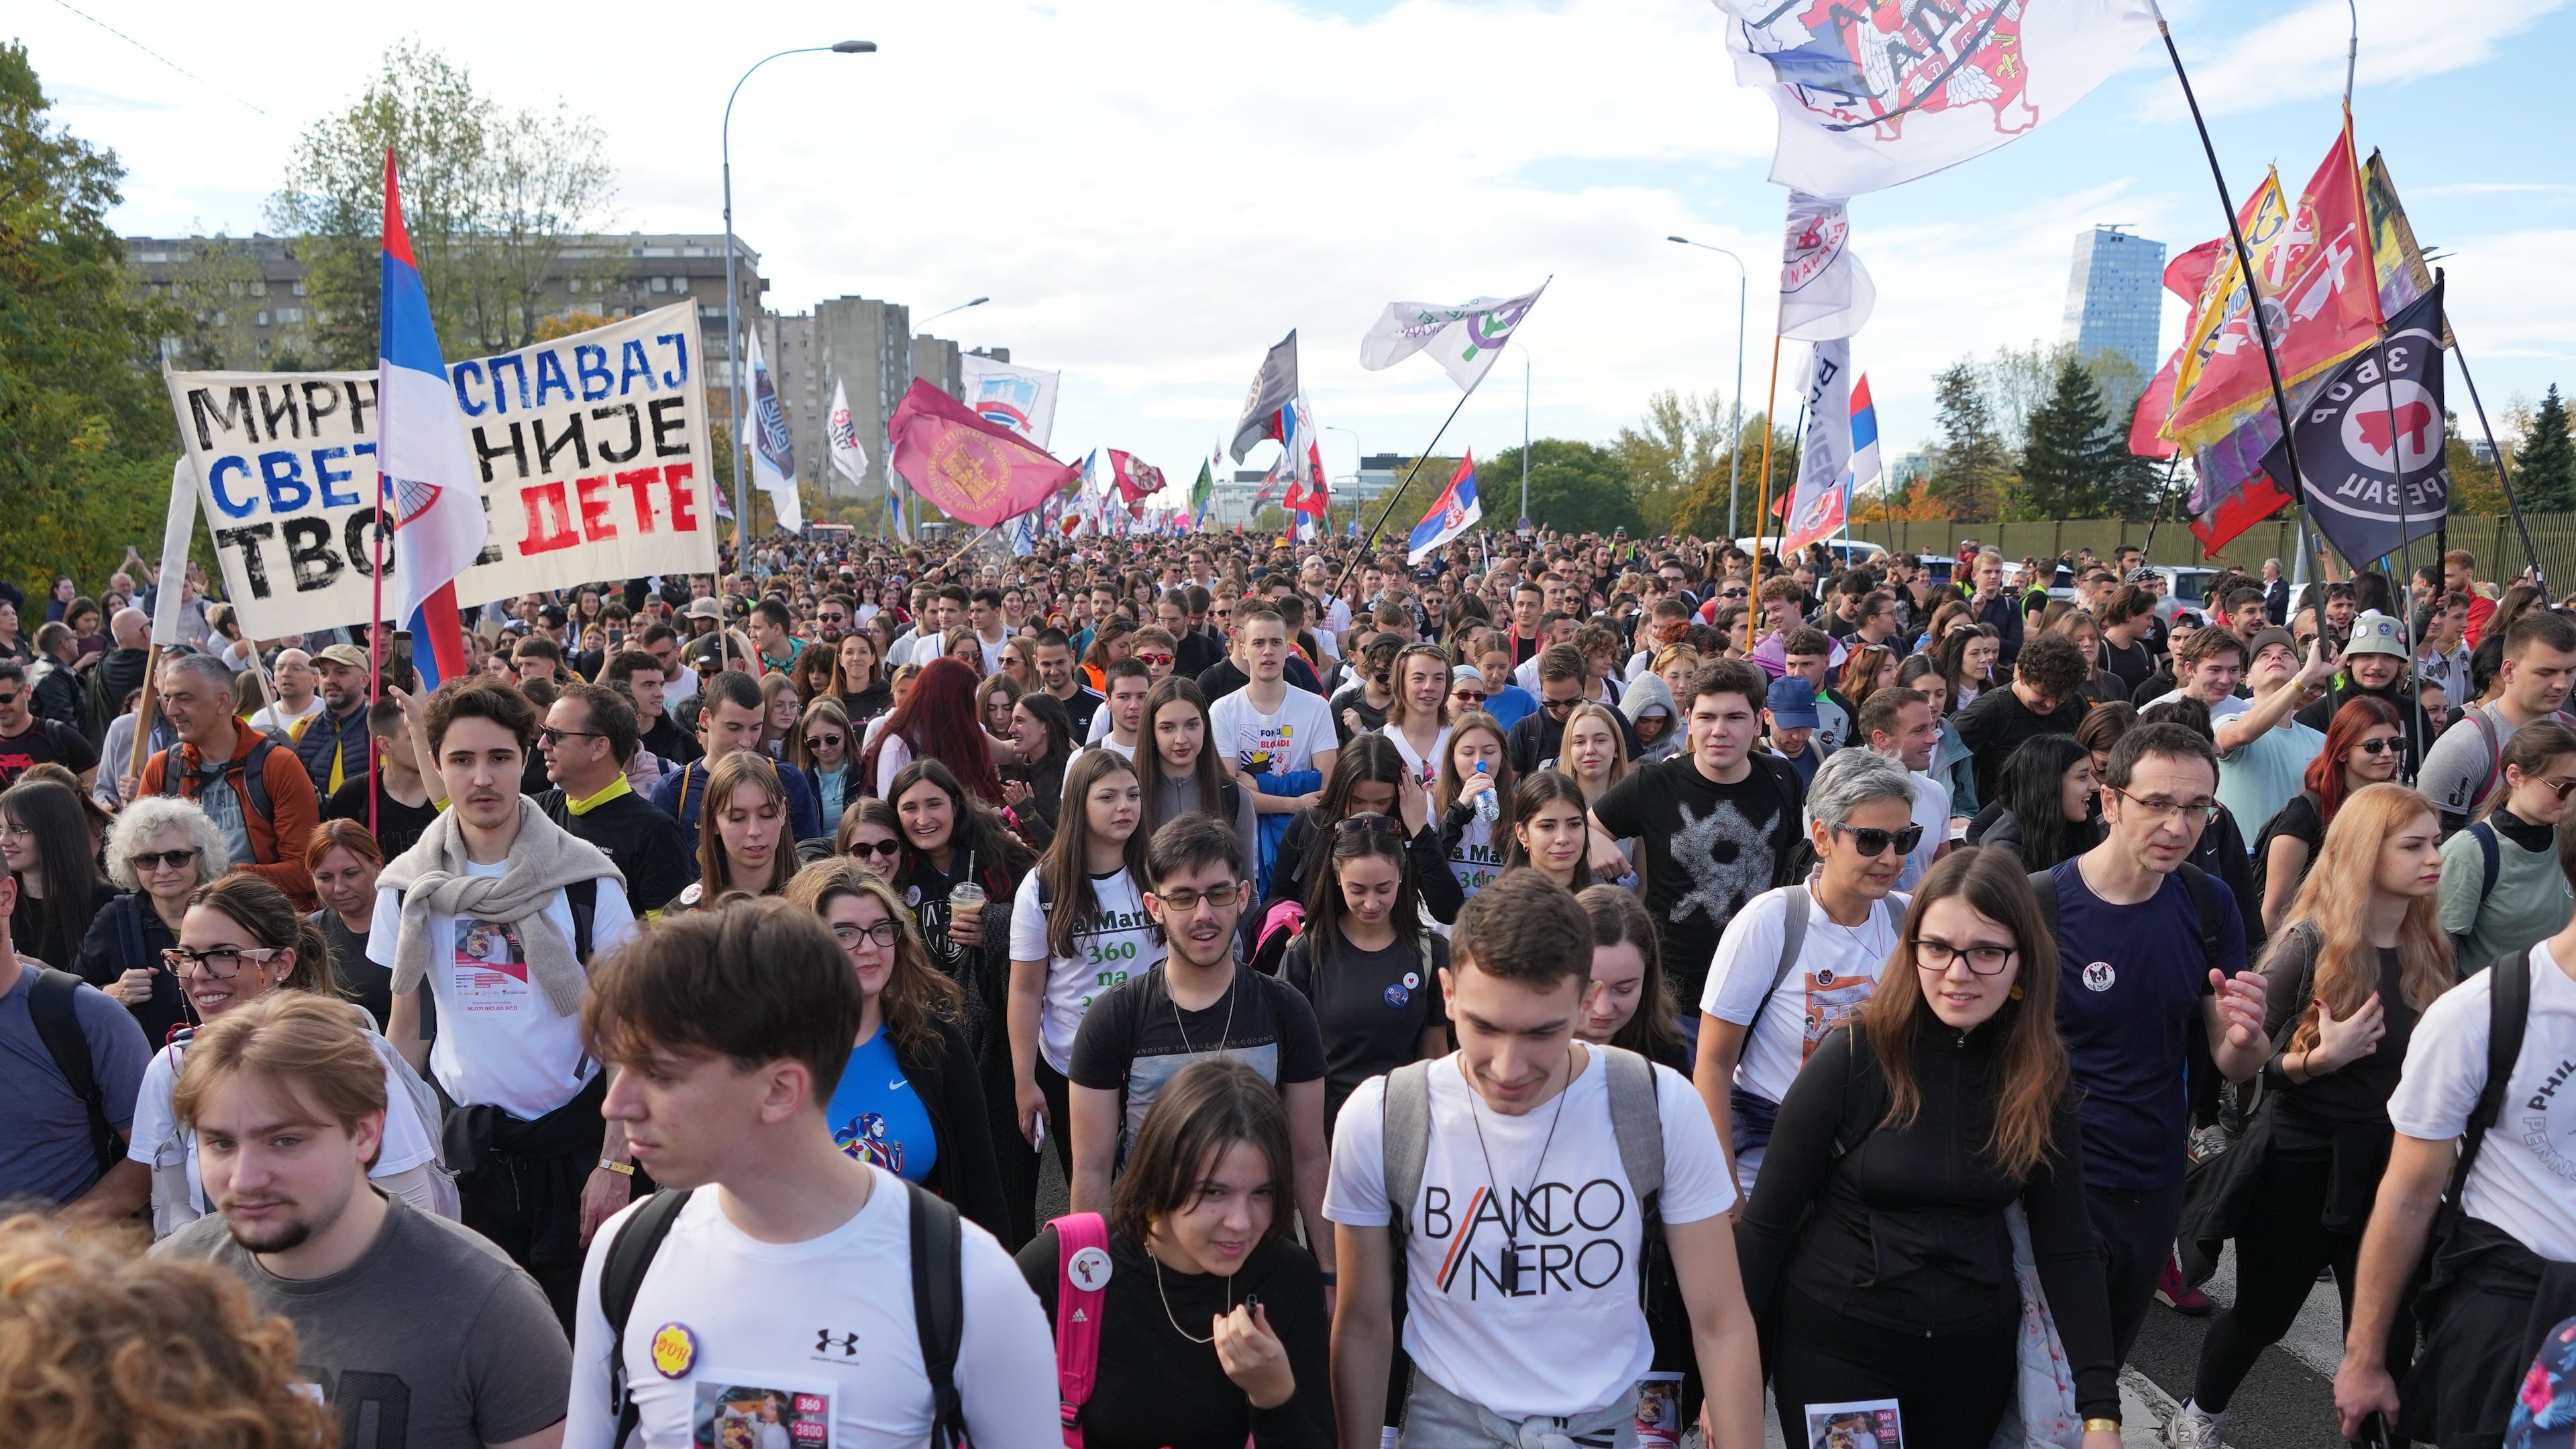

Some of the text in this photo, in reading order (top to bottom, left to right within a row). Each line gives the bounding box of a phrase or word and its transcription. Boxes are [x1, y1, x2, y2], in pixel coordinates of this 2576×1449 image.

[187, 333, 688, 451] МИРН СПАВАЈ
[472, 396, 691, 483] НИЈЕ
[518, 463, 697, 556] ДЕТЕ
[1260, 740, 1289, 748] BLOADI
[1087, 941, 1136, 965] 360
[1097, 971, 1128, 986] na
[1175, 1042, 1209, 1051] THNGS
[1241, 1034, 1273, 1044] COCOMO
[1471, 1239, 1623, 1300] NERO
[800, 1399, 820, 1411] 360
[796, 1424, 822, 1437] 3800
[1880, 1429, 1895, 1438] 3800
